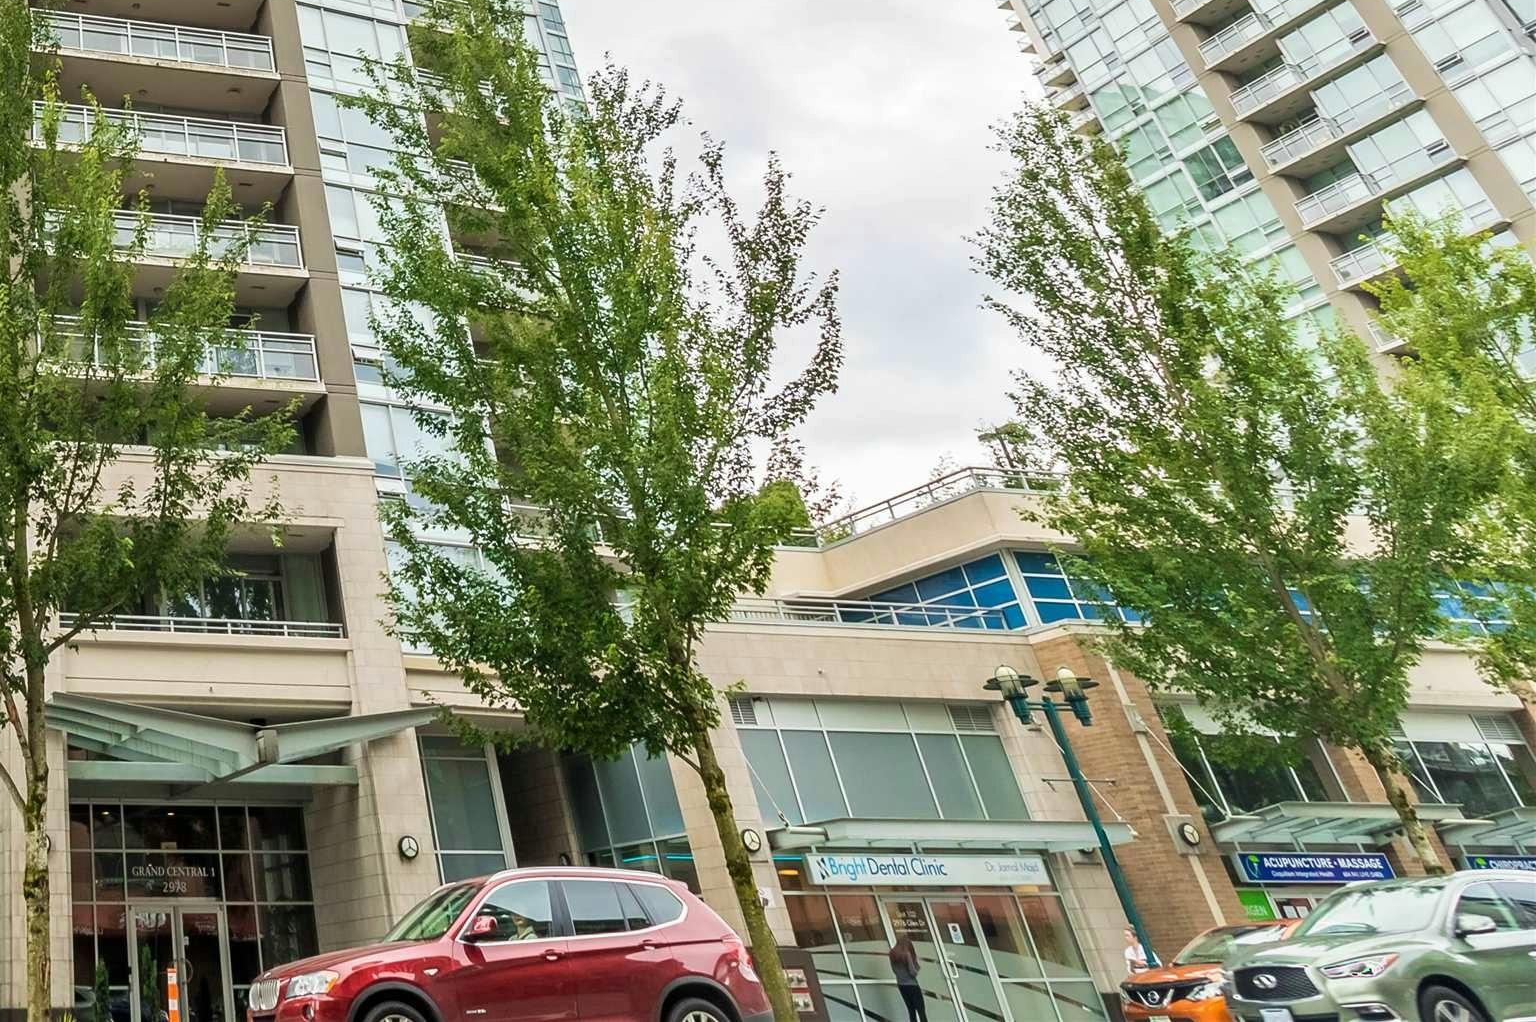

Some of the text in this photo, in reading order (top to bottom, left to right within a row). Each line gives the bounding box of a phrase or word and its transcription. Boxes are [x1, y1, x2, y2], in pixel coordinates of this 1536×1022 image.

[829, 857, 948, 881] Bright Dental Clinic
[1264, 857, 1384, 869] ACUPUNCTURE MASSAGE
[131, 865, 164, 877] GRAND
[166, 866, 208, 877] CENTRAL
